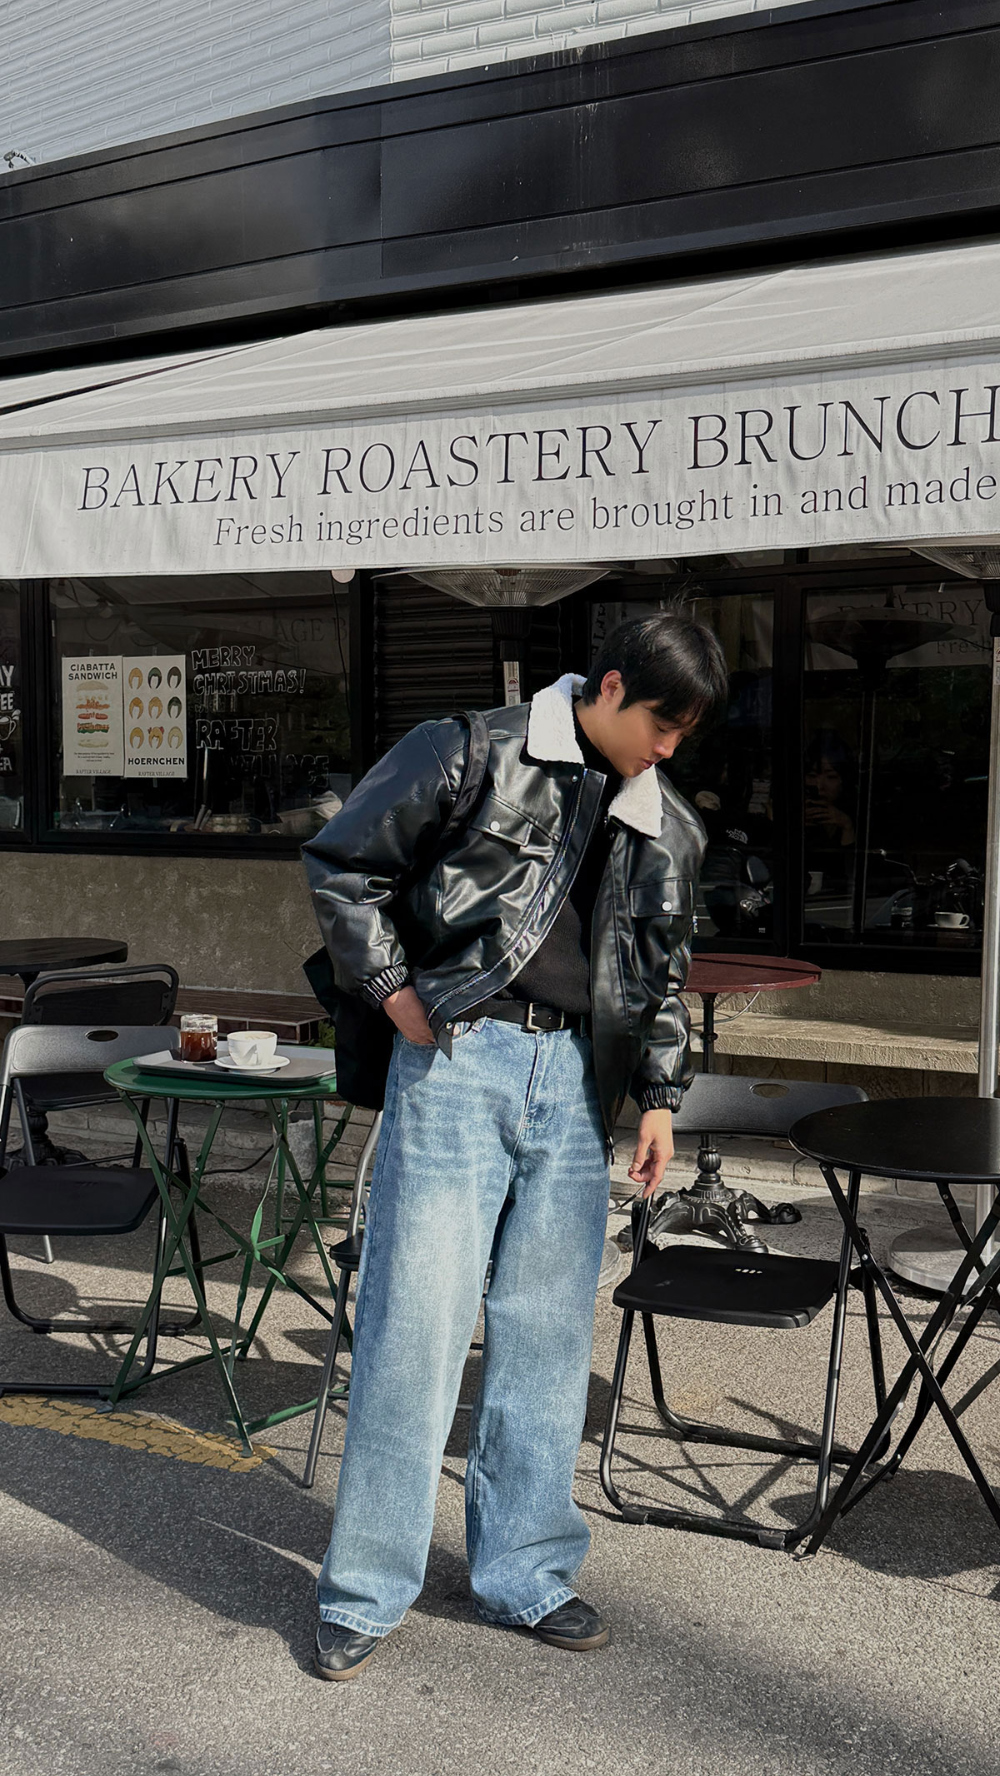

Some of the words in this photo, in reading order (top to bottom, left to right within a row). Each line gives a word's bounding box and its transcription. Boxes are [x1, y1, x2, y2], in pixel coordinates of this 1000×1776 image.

[77, 450, 301, 511] BAKERY
[316, 419, 663, 496] ROASTERY
[686, 384, 1000, 470] BRUNCH
[213, 513, 304, 546] Fresh
[316, 506, 504, 546] ingredients
[519, 508, 575, 533] are
[591, 488, 735, 531] brought
[750, 483, 784, 518] in
[800, 474, 870, 517] and
[884, 466, 998, 507] made
[70, 663, 115, 672] CIABATTA
[191, 645, 256, 670] MERRY
[68, 672, 118, 681] SANDWICH
[193, 668, 307, 696] CHRISTMAS!
[128, 757, 185, 766] HOERNCHEN
